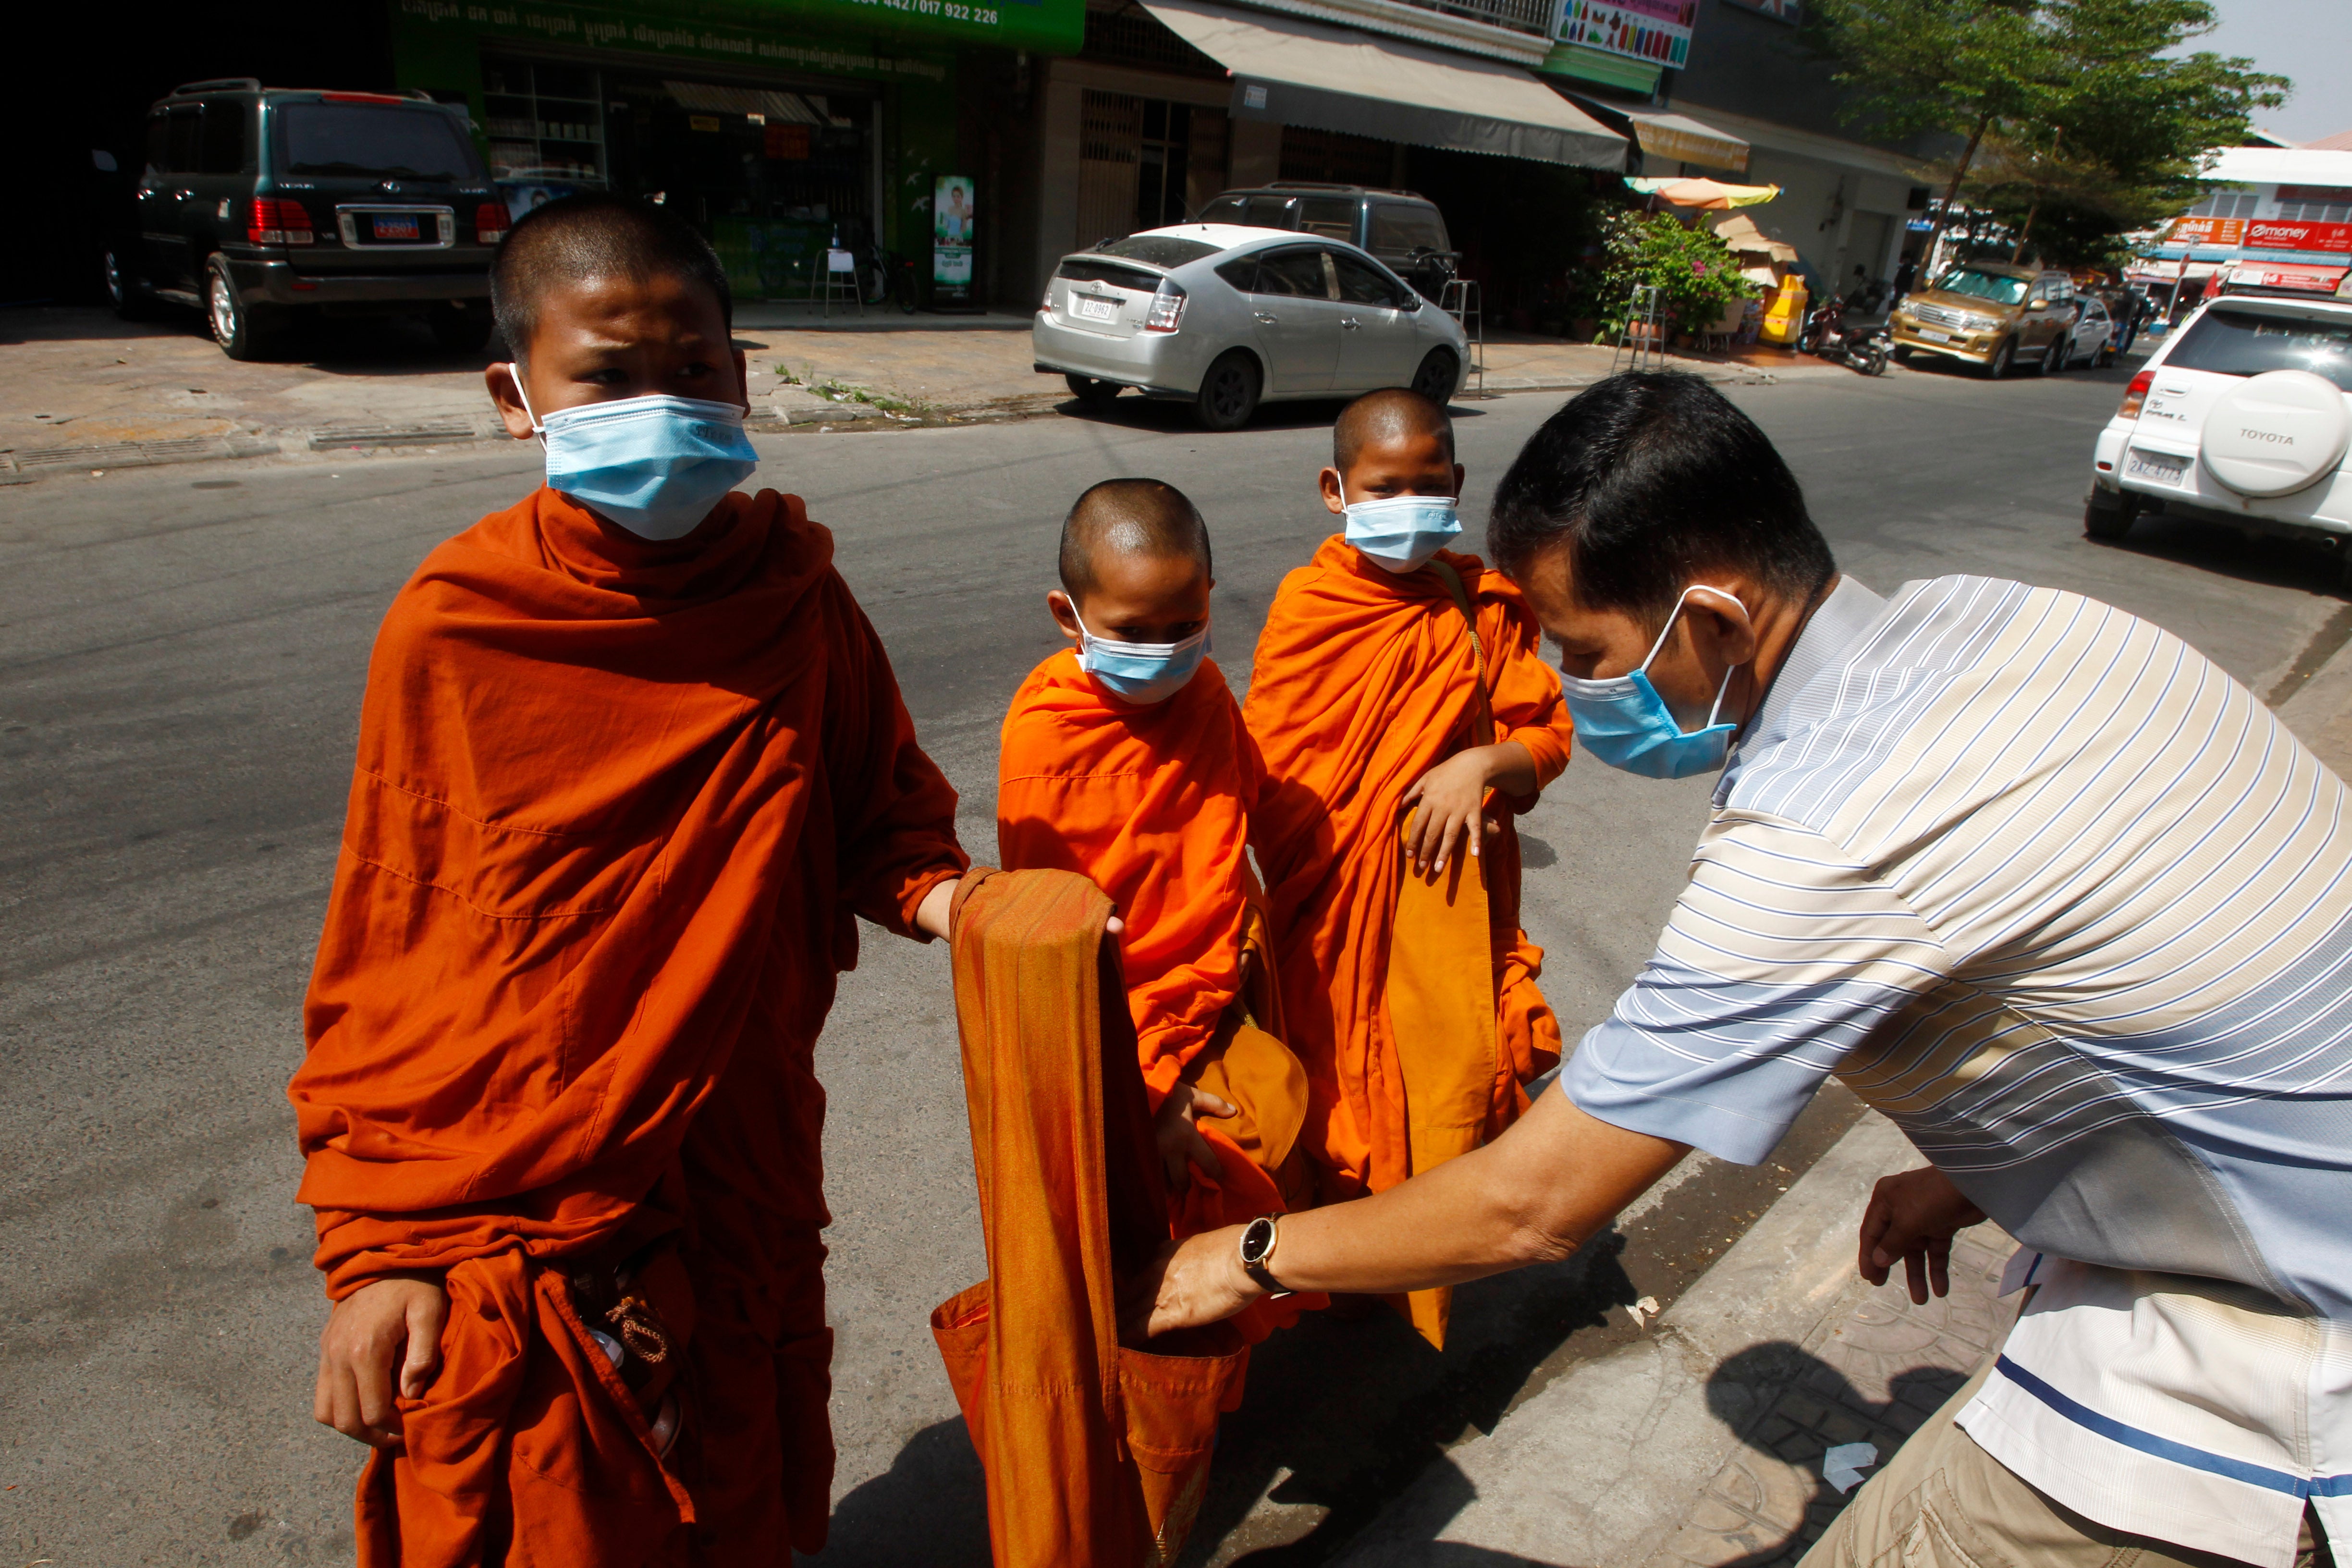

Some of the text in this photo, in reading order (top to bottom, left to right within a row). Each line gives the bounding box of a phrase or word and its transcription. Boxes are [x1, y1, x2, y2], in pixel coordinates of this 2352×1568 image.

[945, 2, 970, 20] 922
[973, 7, 998, 24] 226
[1085, 302, 1109, 315] 2Z-0962
[2241, 429, 2293, 446] TOYOTA
